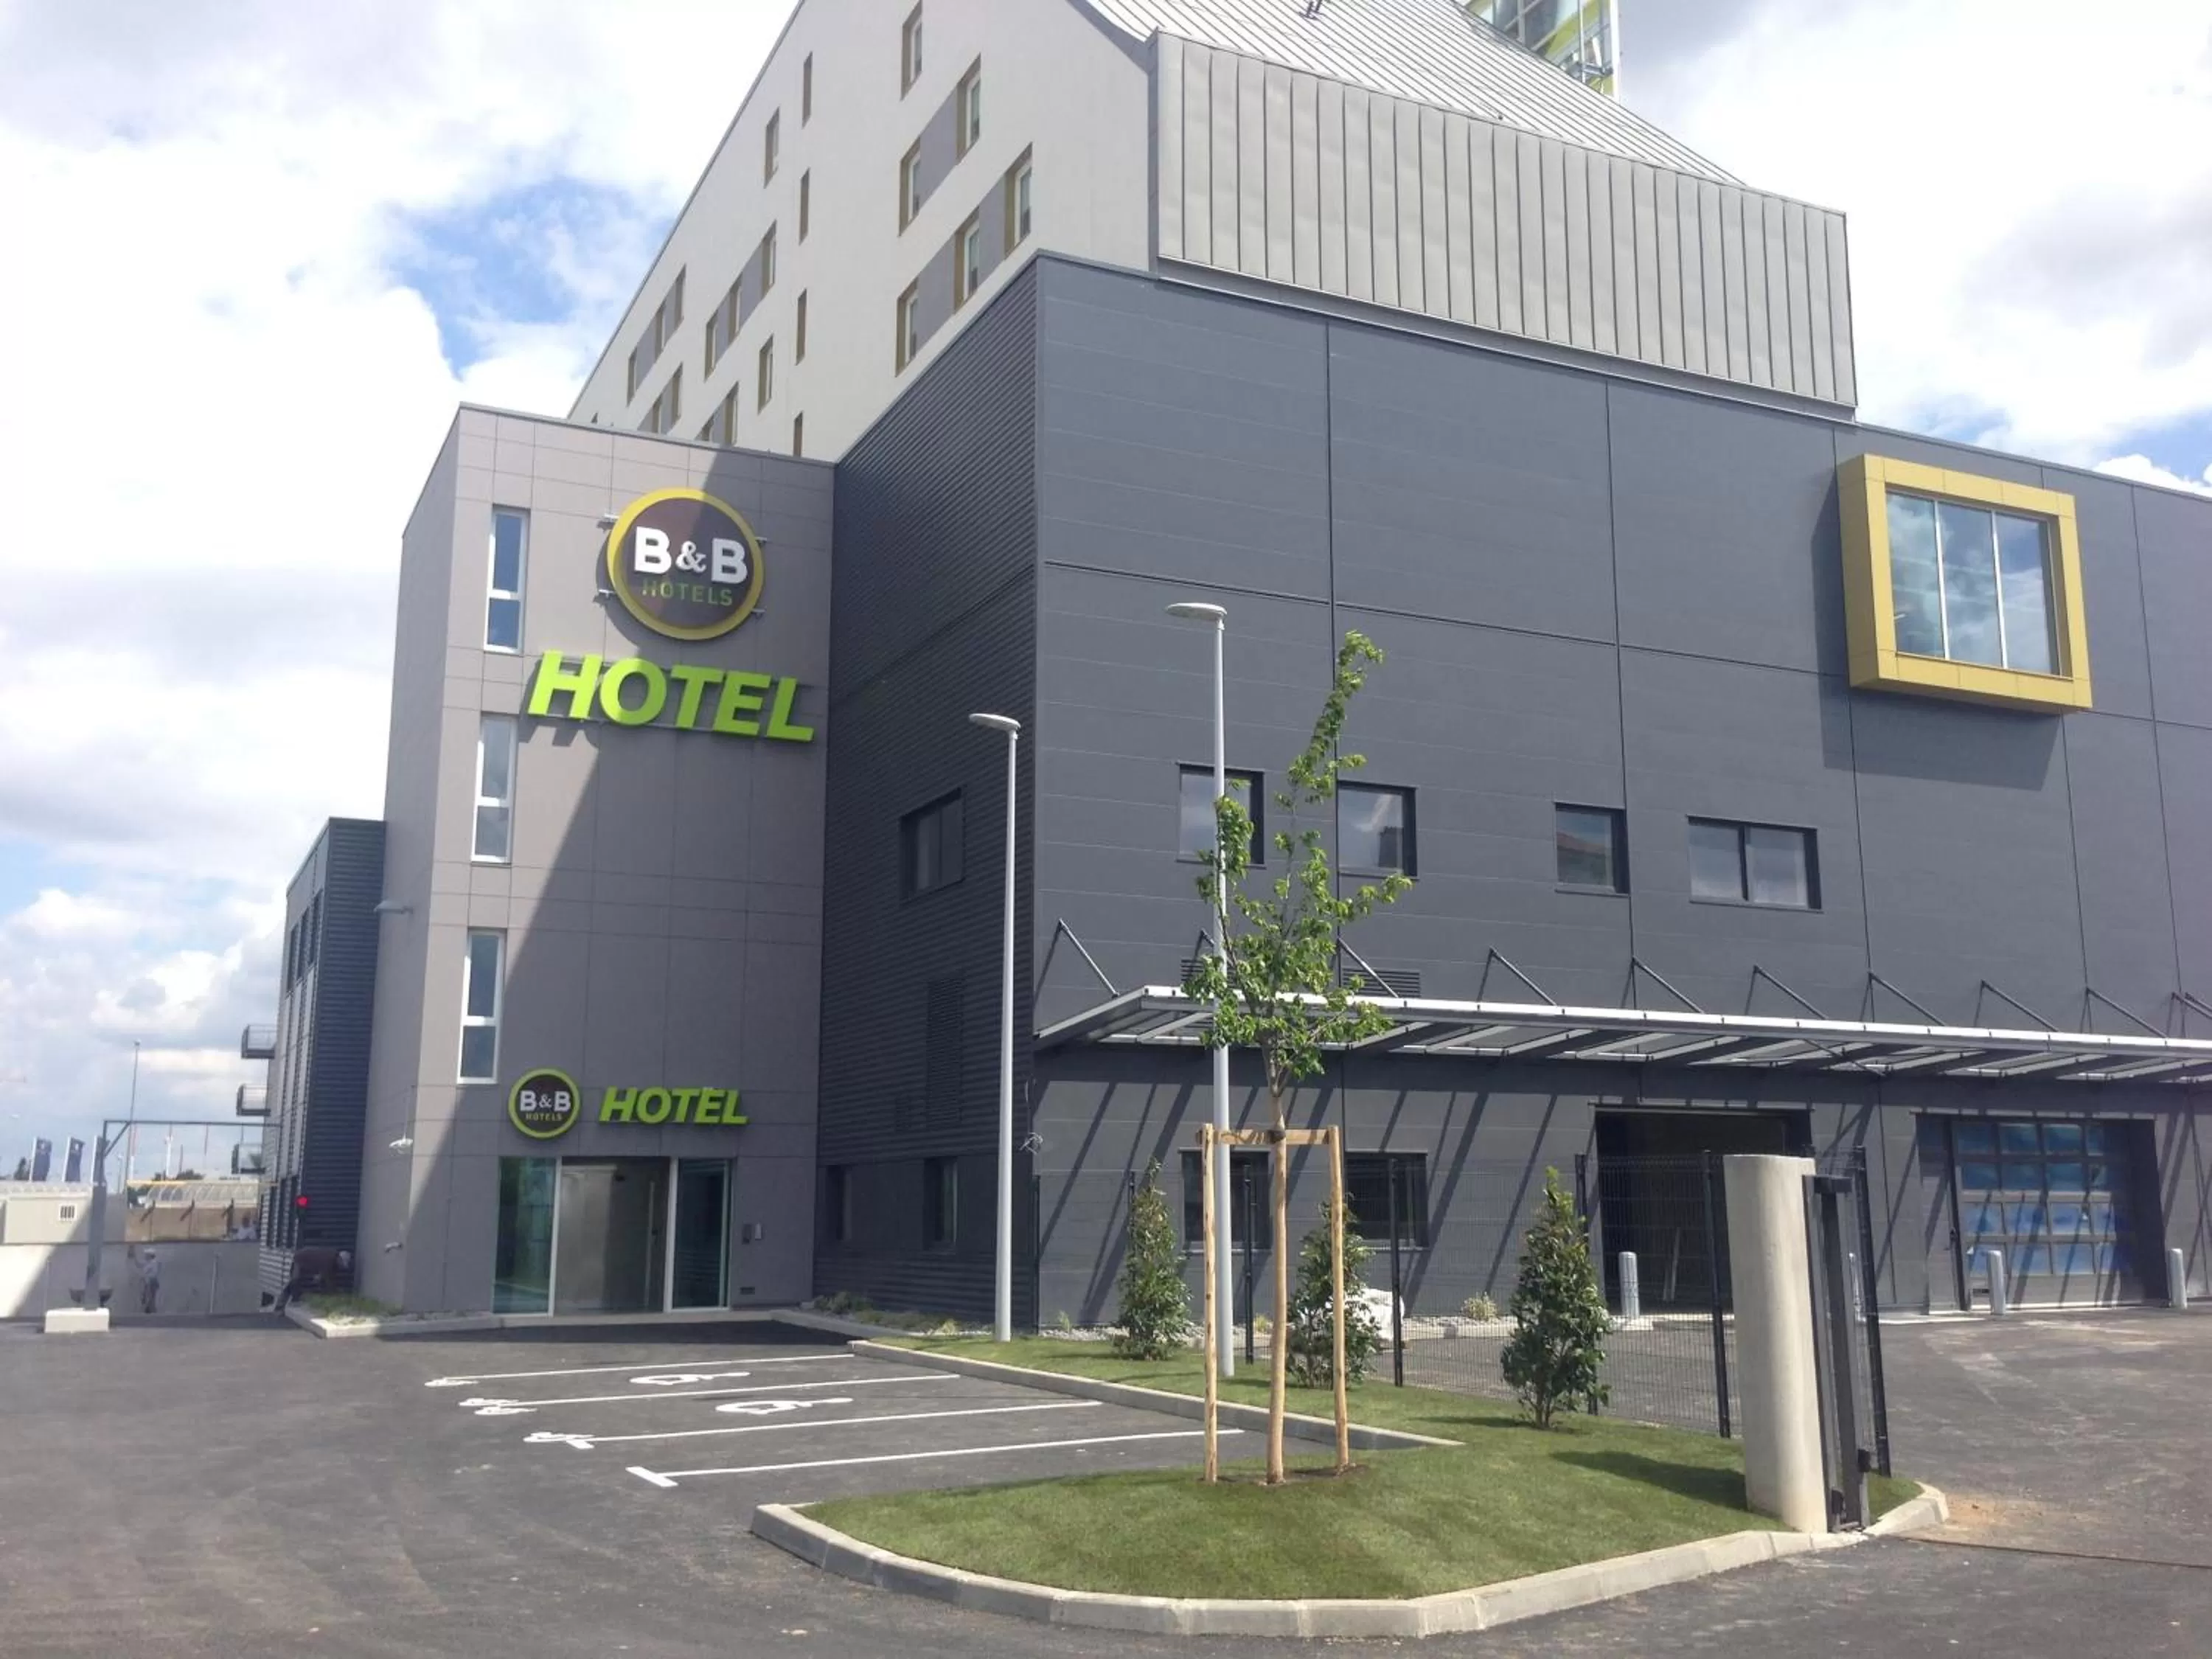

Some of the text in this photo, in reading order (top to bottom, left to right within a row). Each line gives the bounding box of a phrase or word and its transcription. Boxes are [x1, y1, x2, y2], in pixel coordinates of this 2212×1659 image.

[634, 526, 748, 584] B&B
[642, 578, 734, 607] HOTELS
[527, 649, 815, 742] HOTEL
[519, 1090, 571, 1112] B&B
[525, 1113, 563, 1121] HOTELS
[598, 1086, 749, 1124] HOTEL
